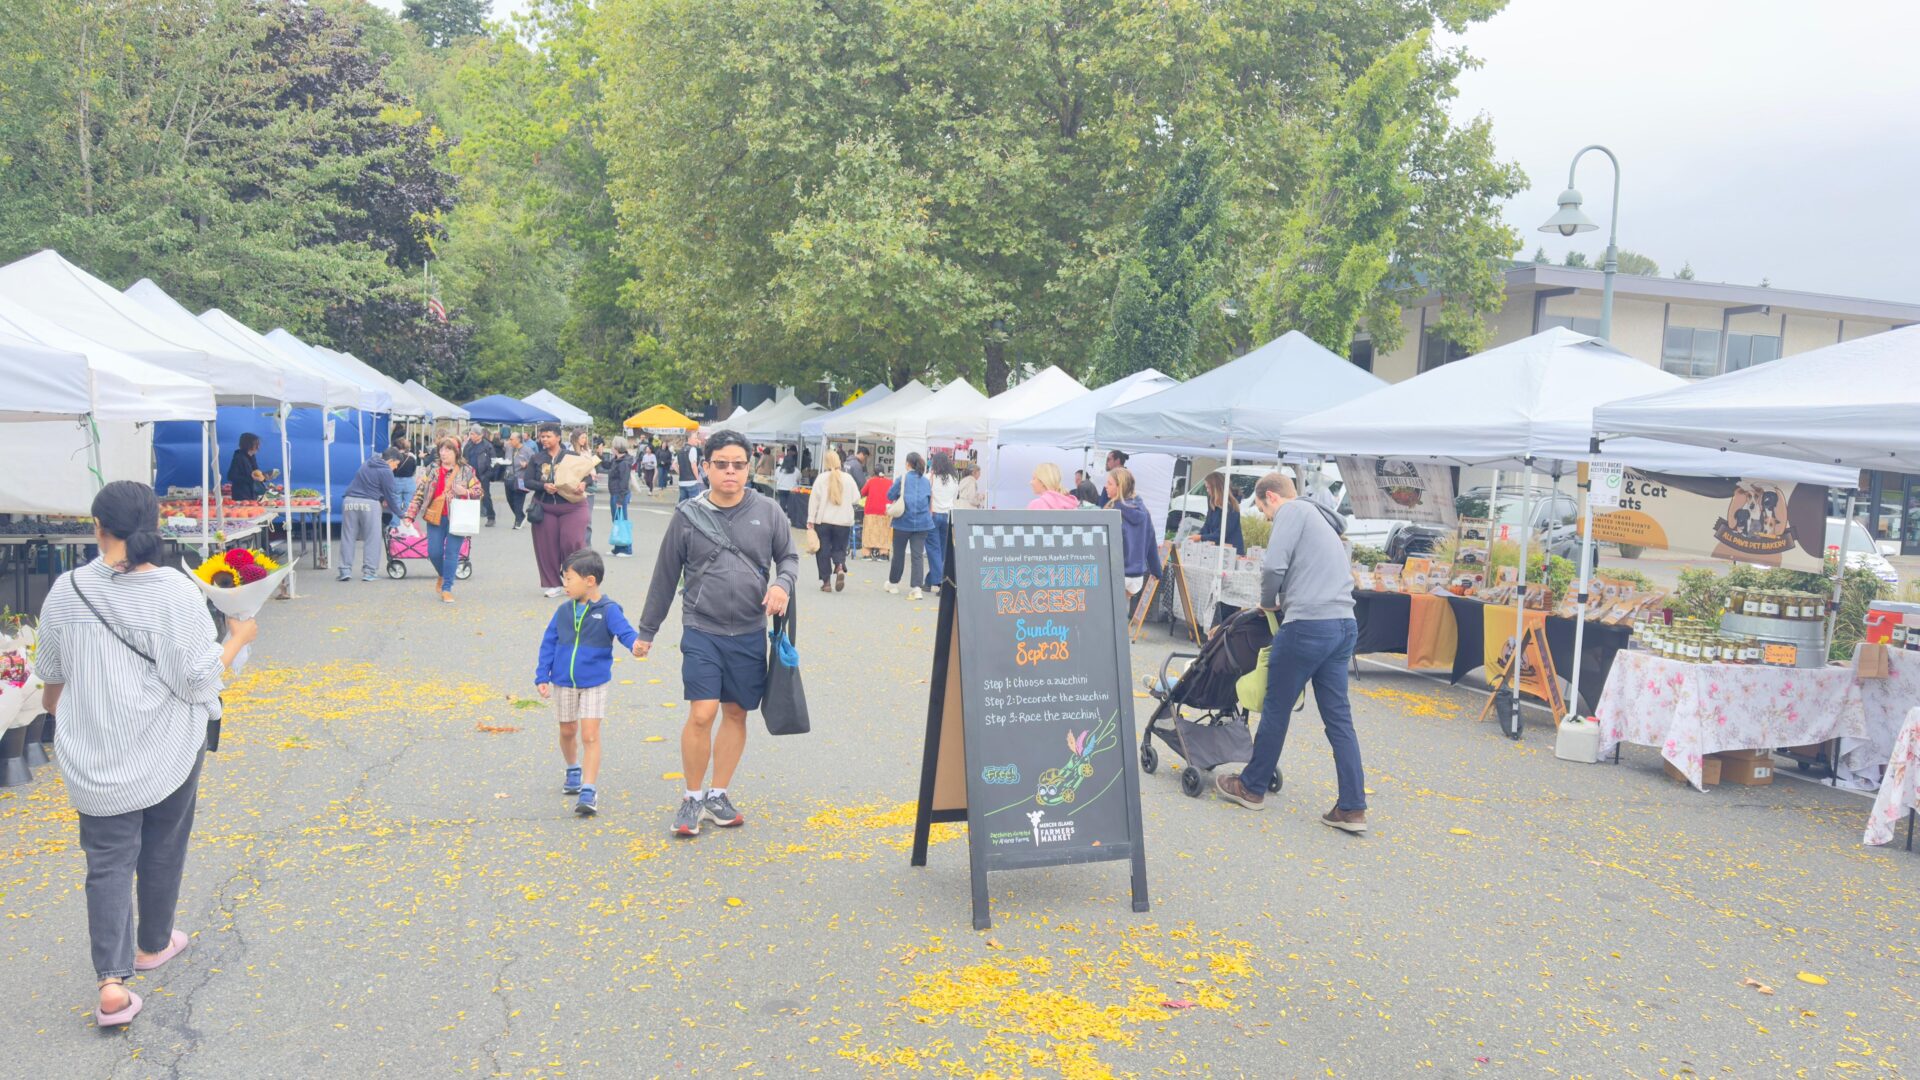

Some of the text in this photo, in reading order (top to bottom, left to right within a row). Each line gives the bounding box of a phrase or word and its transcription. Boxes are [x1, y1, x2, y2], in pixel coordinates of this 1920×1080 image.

[1625, 481, 1668, 498] & Cat
[344, 502, 371, 512] ROOTS
[1619, 497, 1642, 510] ats
[1615, 519, 1651, 530] INGREDIENTS
[1631, 527, 1644, 535] FREE
[1602, 530, 1626, 538] NATURAL
[1722, 531, 1786, 550] ALL PAWS PET BAKERY
[982, 555, 1003, 563] Mercer
[1004, 553, 1021, 562] Island
[1048, 553, 1069, 561] Market
[980, 563, 1098, 590] ZUCCHINI
[996, 588, 1086, 615] RACES!
[1015, 618, 1069, 641] Sunday
[1049, 641, 1070, 660] 28
[983, 679, 1003, 693] Step
[1013, 676, 1045, 688] Choose
[1054, 673, 1088, 685] zucchini
[985, 696, 1004, 709] Step
[1016, 693, 1057, 705] Decorate
[1060, 692, 1075, 702] the
[1075, 690, 1109, 702] zucchini
[985, 713, 1006, 726] Step
[1019, 712, 1041, 723] Race
[1044, 710, 1060, 722] the
[1040, 827, 1075, 836] FARMERS
[1041, 834, 1071, 842] MARKET
